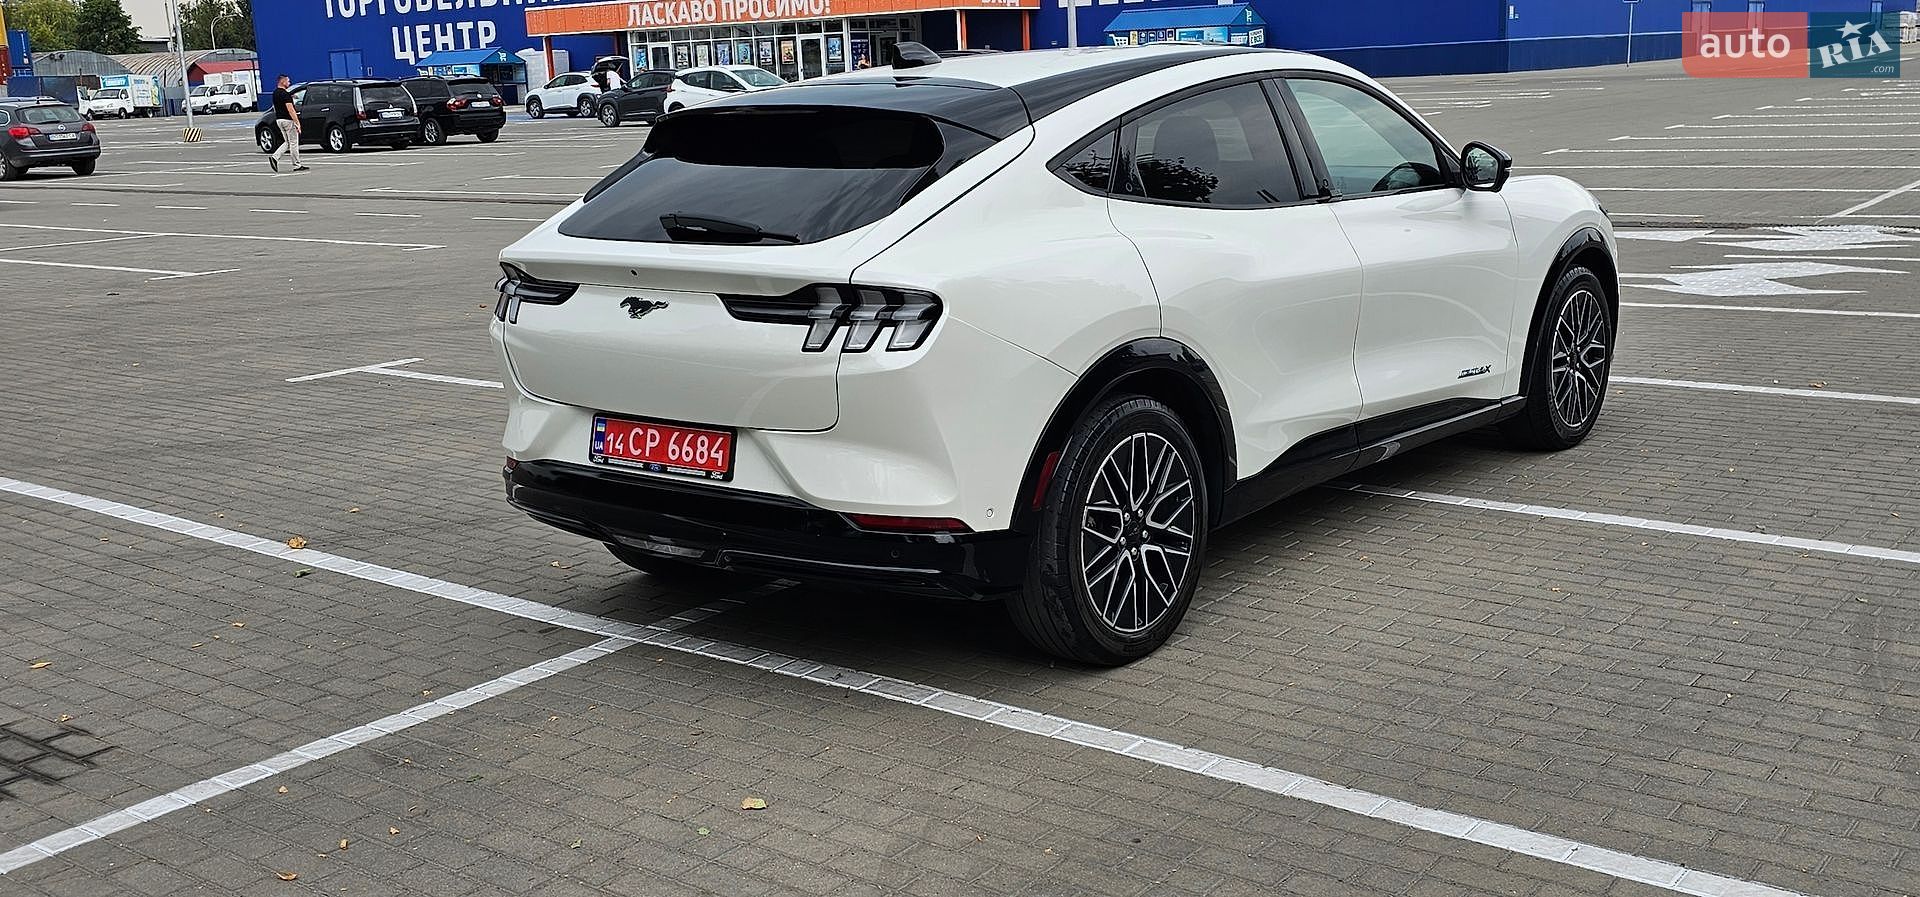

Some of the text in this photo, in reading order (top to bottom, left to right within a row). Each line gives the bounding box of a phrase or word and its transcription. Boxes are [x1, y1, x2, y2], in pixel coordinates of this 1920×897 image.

[628, 0, 831, 27] ЛАСКАВО ПРОСИМО!
[391, 20, 497, 65] ЦЕНТР
[594, 440, 604, 450] UA
[668, 431, 724, 467] 6684
